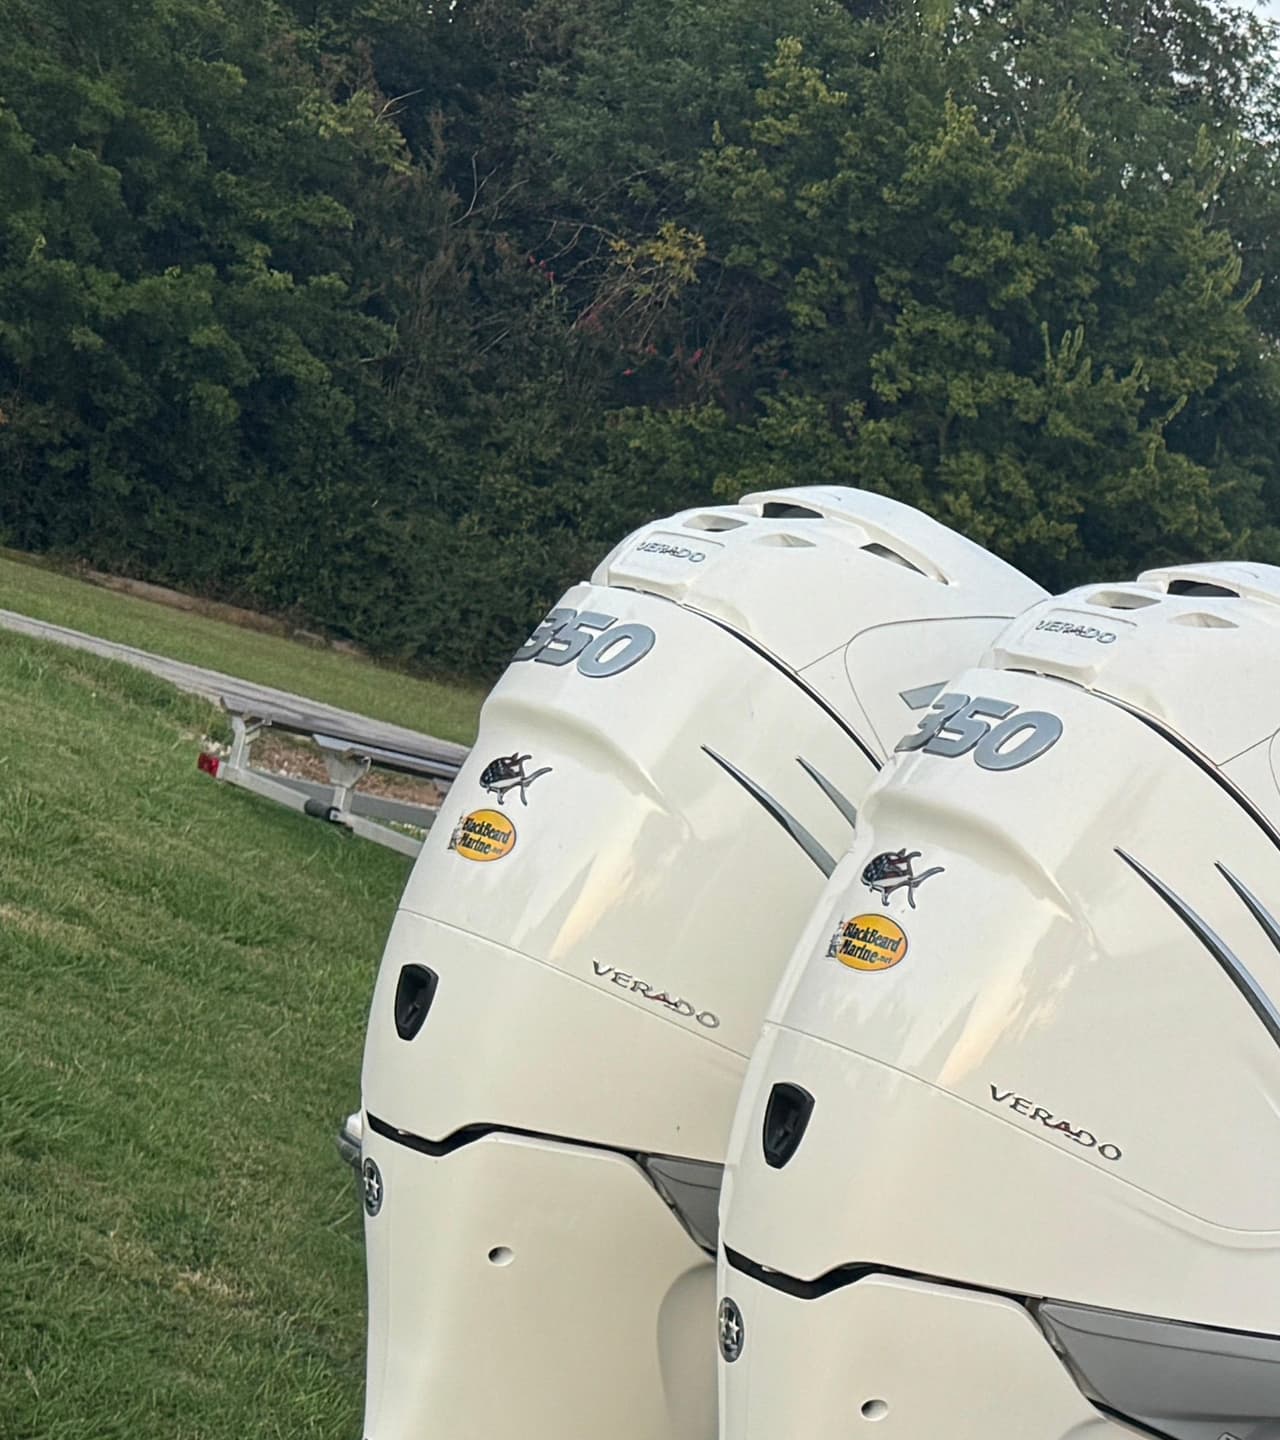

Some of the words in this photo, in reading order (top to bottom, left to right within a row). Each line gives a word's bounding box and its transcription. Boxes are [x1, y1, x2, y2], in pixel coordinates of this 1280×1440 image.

[636, 541, 706, 563] VERADO
[511, 607, 656, 679] 350
[1035, 620, 1117, 644] VERADO
[893, 680, 1063, 772] 350
[843, 922, 903, 953] BlackBeard
[593, 960, 721, 1029] VERADO
[990, 1083, 1122, 1161] VERADO
